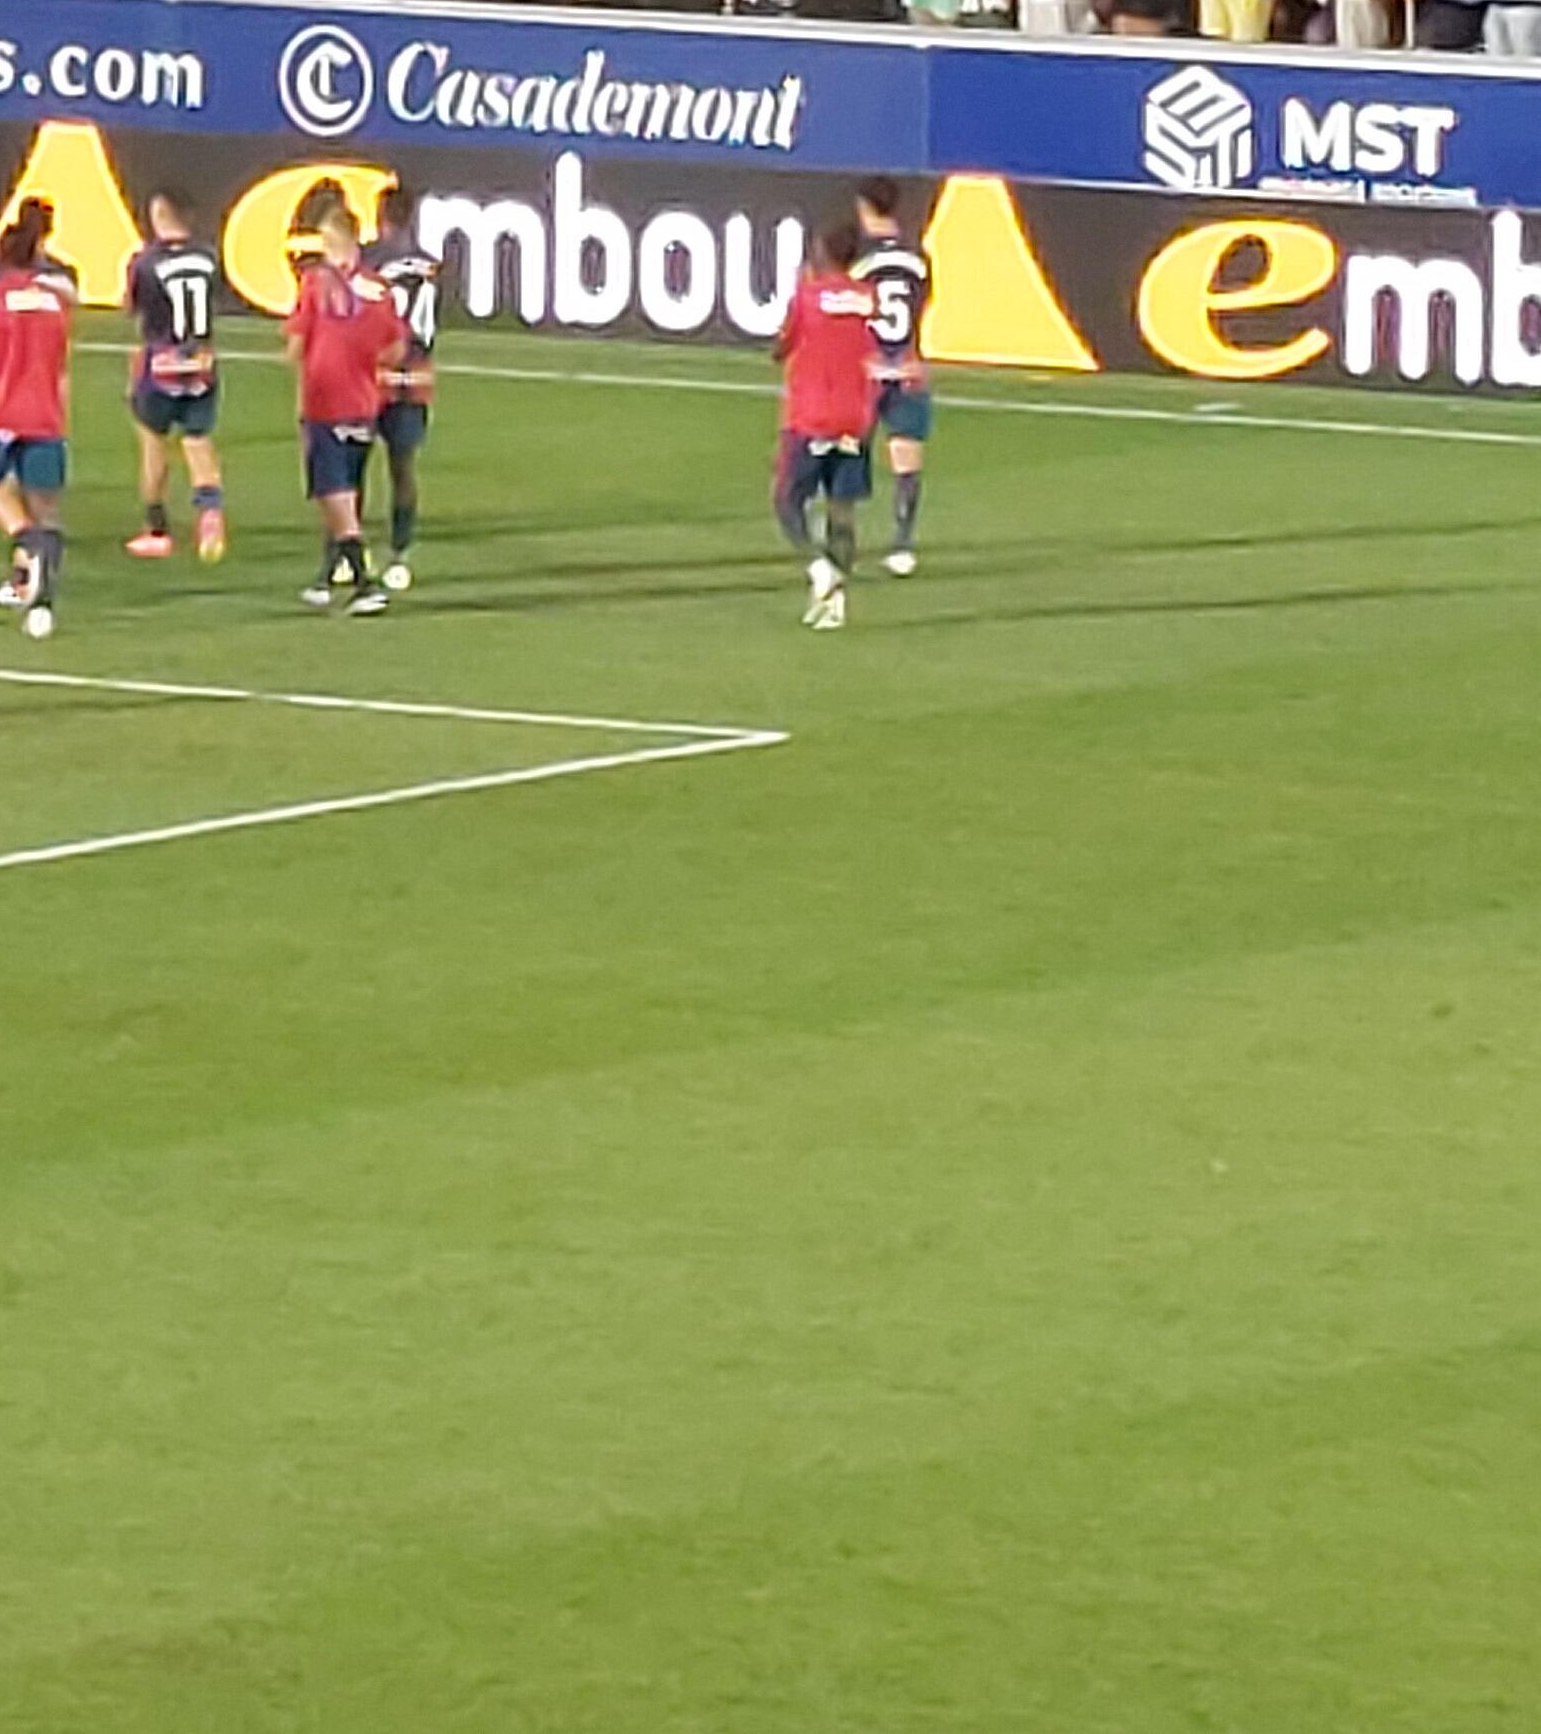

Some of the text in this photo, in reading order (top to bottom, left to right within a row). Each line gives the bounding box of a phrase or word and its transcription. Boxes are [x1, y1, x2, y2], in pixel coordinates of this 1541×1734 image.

[386, 41, 806, 152] Casademont
[1282, 97, 1457, 178] MST
[166, 275, 209, 342] 11
[866, 280, 911, 343] 5
